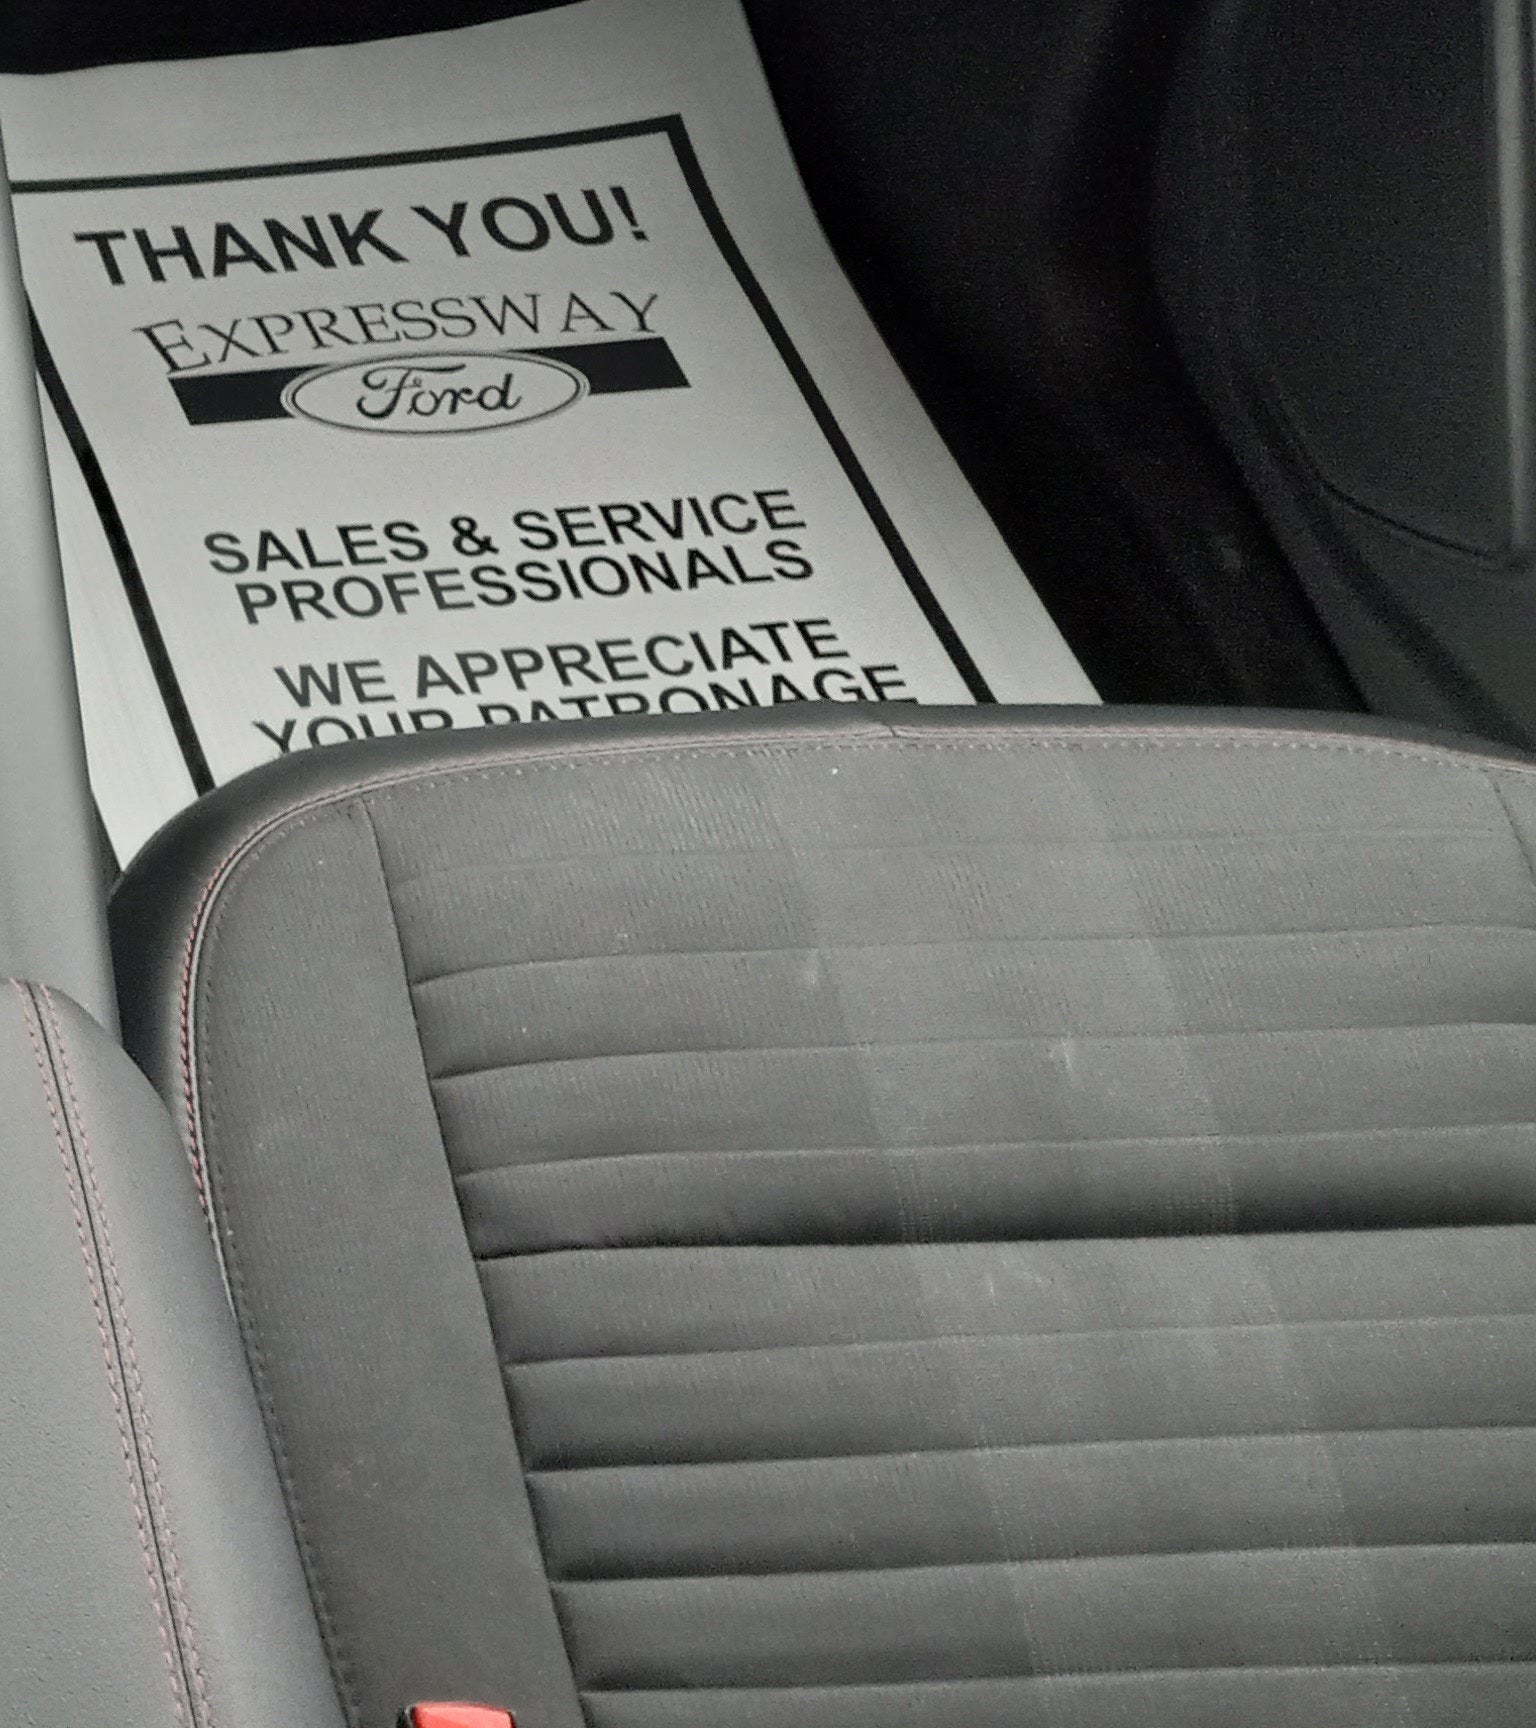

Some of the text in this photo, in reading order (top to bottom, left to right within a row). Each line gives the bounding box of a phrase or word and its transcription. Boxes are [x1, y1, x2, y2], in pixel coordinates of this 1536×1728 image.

[74, 185, 649, 287] THANK YOU!
[132, 291, 660, 375] EXPRESSWAY
[356, 363, 523, 421] Ford
[203, 487, 808, 575] SALES & SERVICE
[235, 540, 815, 624] PROFESSIONALS
[274, 618, 849, 708] WE APPRECIATE
